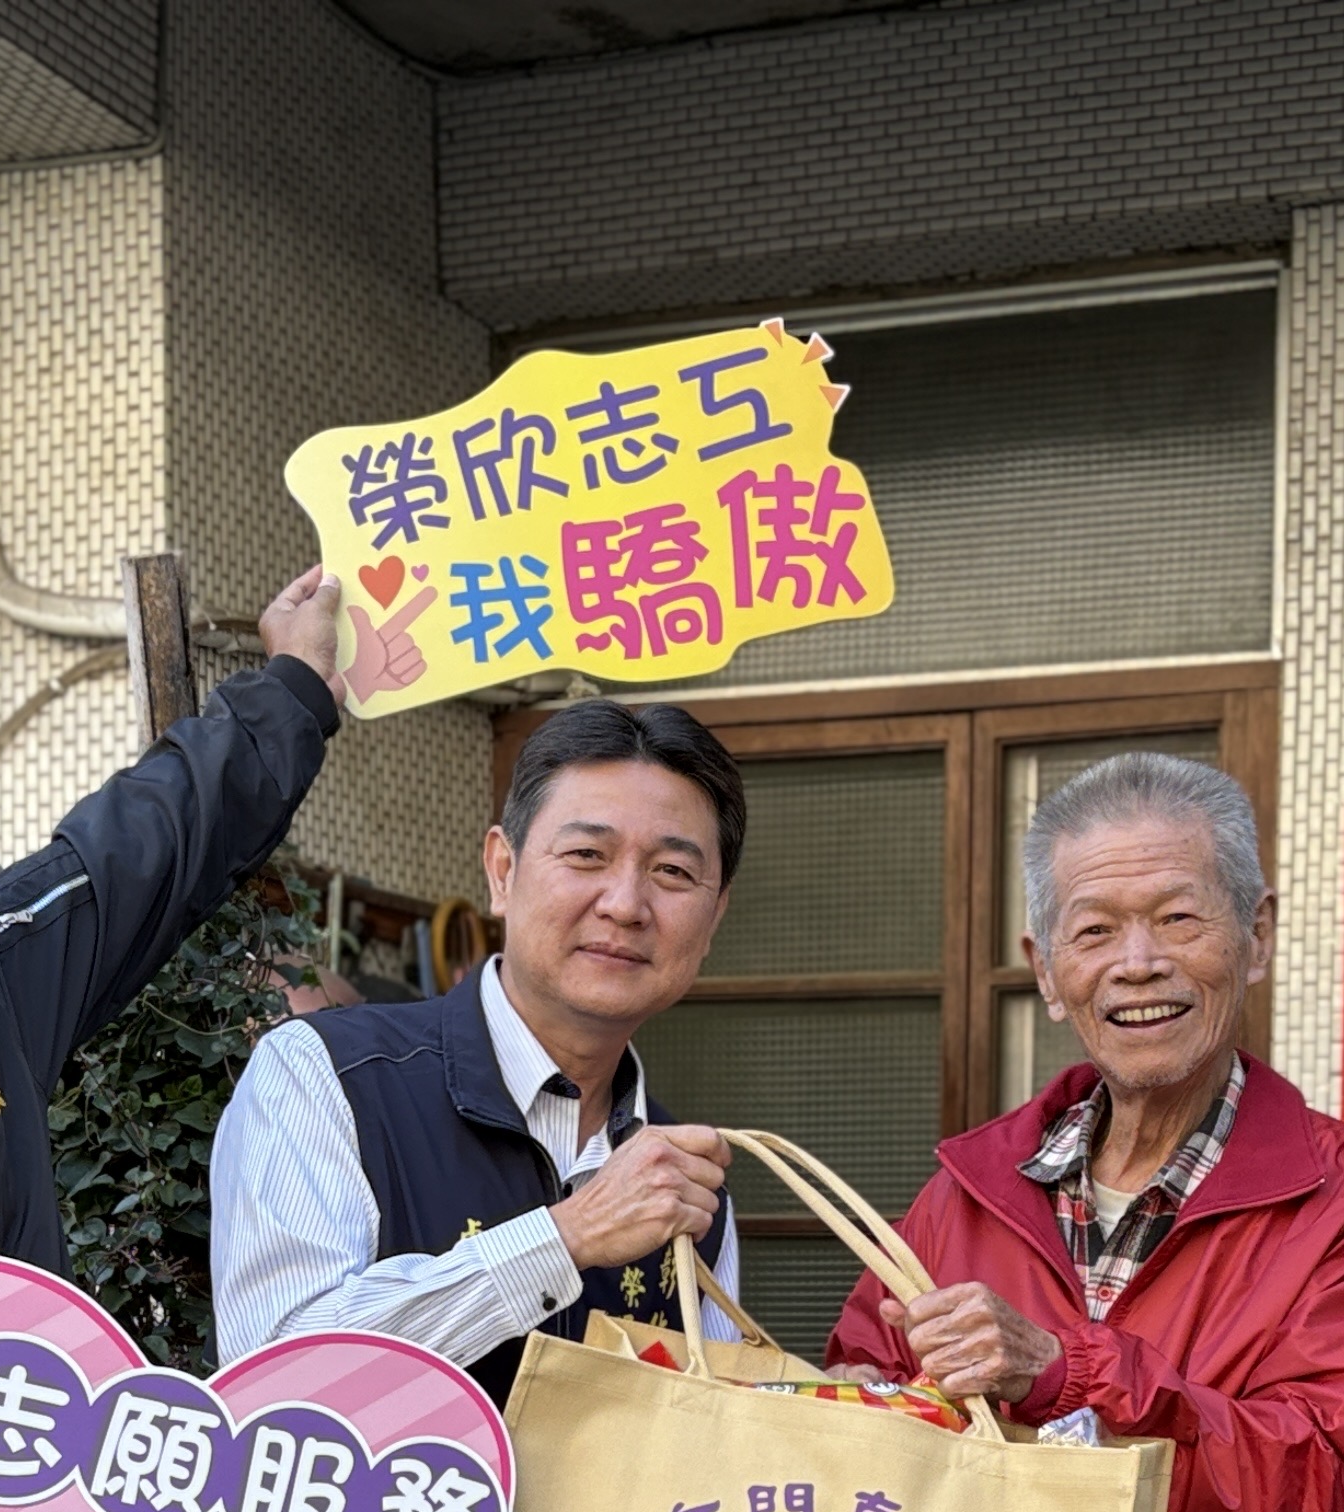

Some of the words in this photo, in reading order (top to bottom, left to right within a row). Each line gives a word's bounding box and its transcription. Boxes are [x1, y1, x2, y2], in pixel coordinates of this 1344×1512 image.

[341, 347, 793, 551] 榮欣志工
[449, 463, 866, 663] 我驕傲
